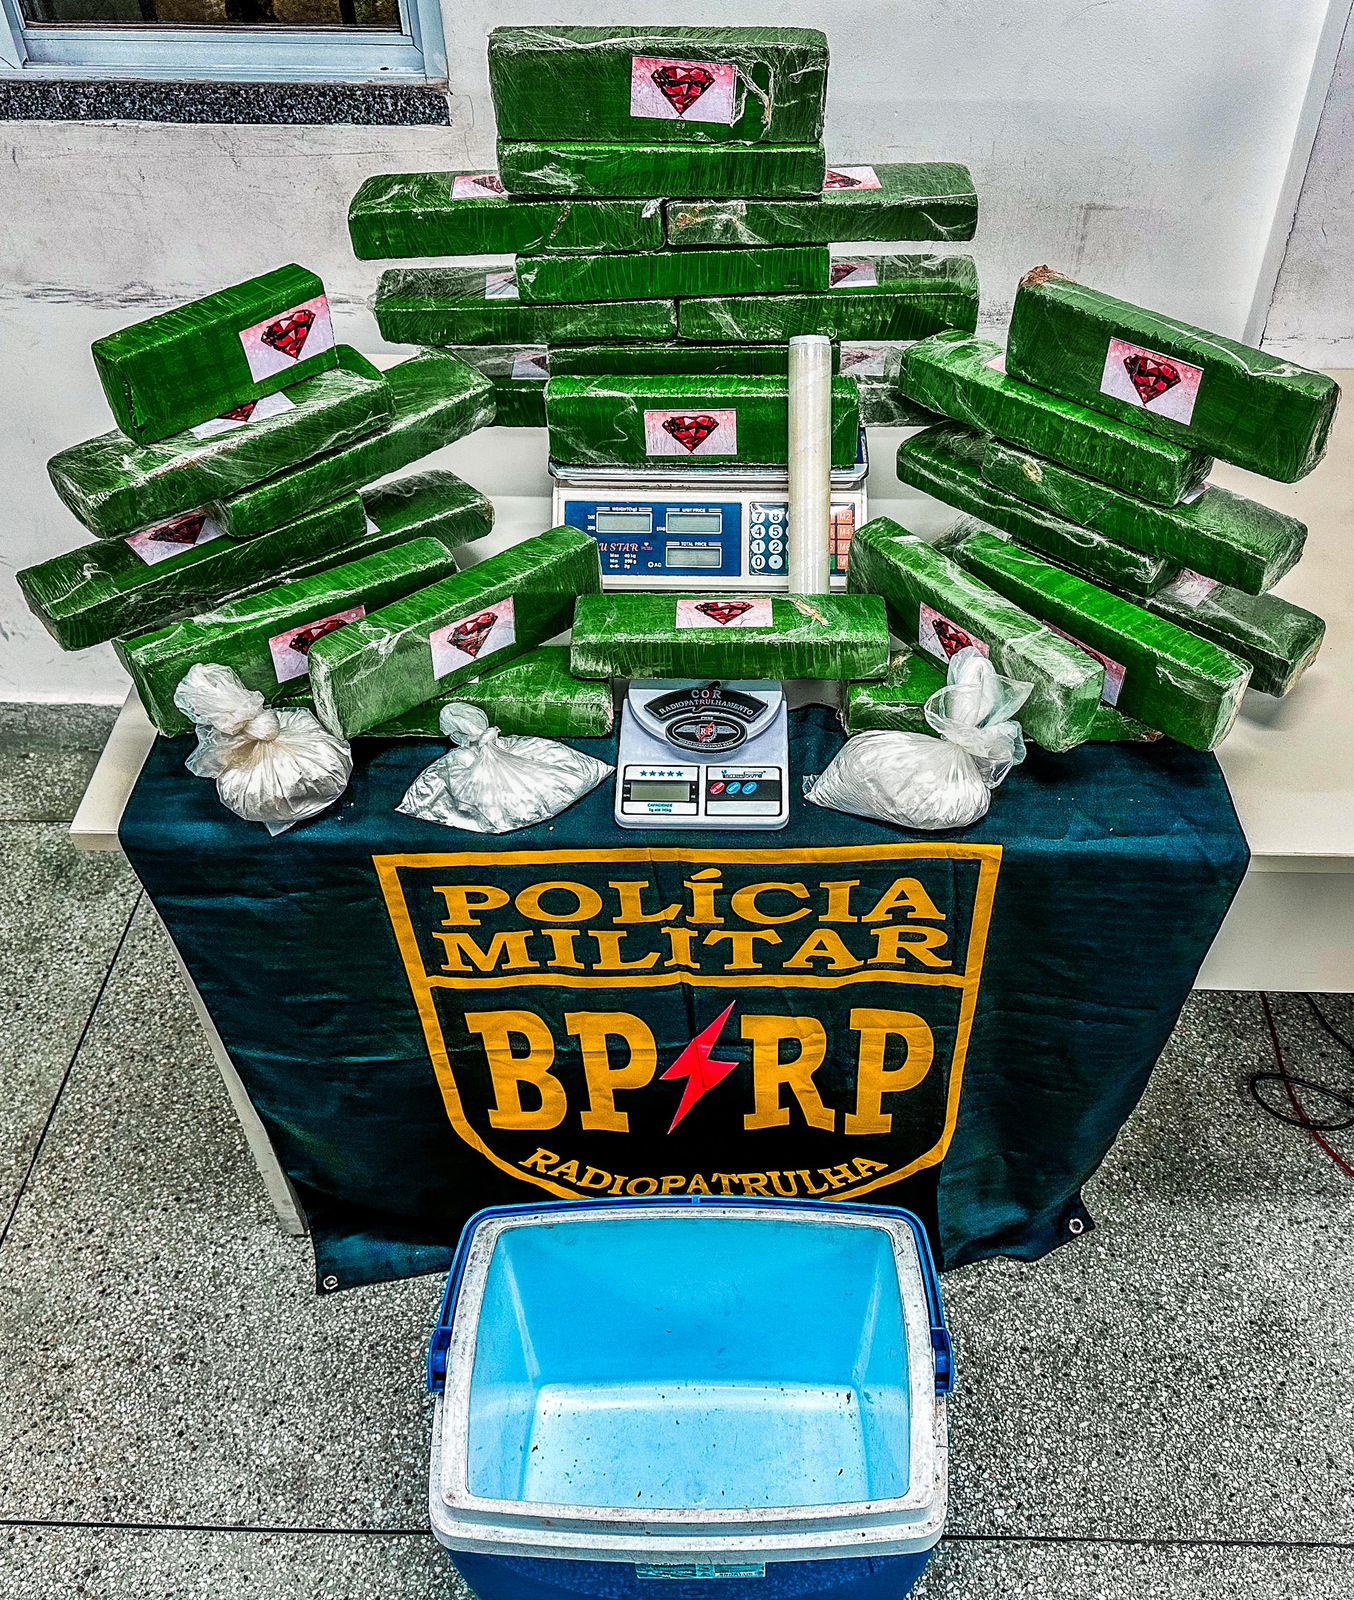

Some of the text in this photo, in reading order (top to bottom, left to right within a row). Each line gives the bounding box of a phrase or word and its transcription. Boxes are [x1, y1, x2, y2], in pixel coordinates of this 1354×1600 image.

[755, 512, 779, 521] 7 8
[755, 527, 779, 536] 4 5
[610, 543, 638, 552] STAR
[756, 542, 779, 551] 1 2
[755, 557, 762, 566] 0
[691, 689, 722, 699] COR
[658, 698, 754, 716] RADIOPATRULHAMENTO
[432, 868, 947, 927] POLÍCIA
[432, 926, 953, 972] MILITAR
[463, 1007, 935, 1136] BP RP
[518, 1146, 889, 1197] RADIOPATRULHA
